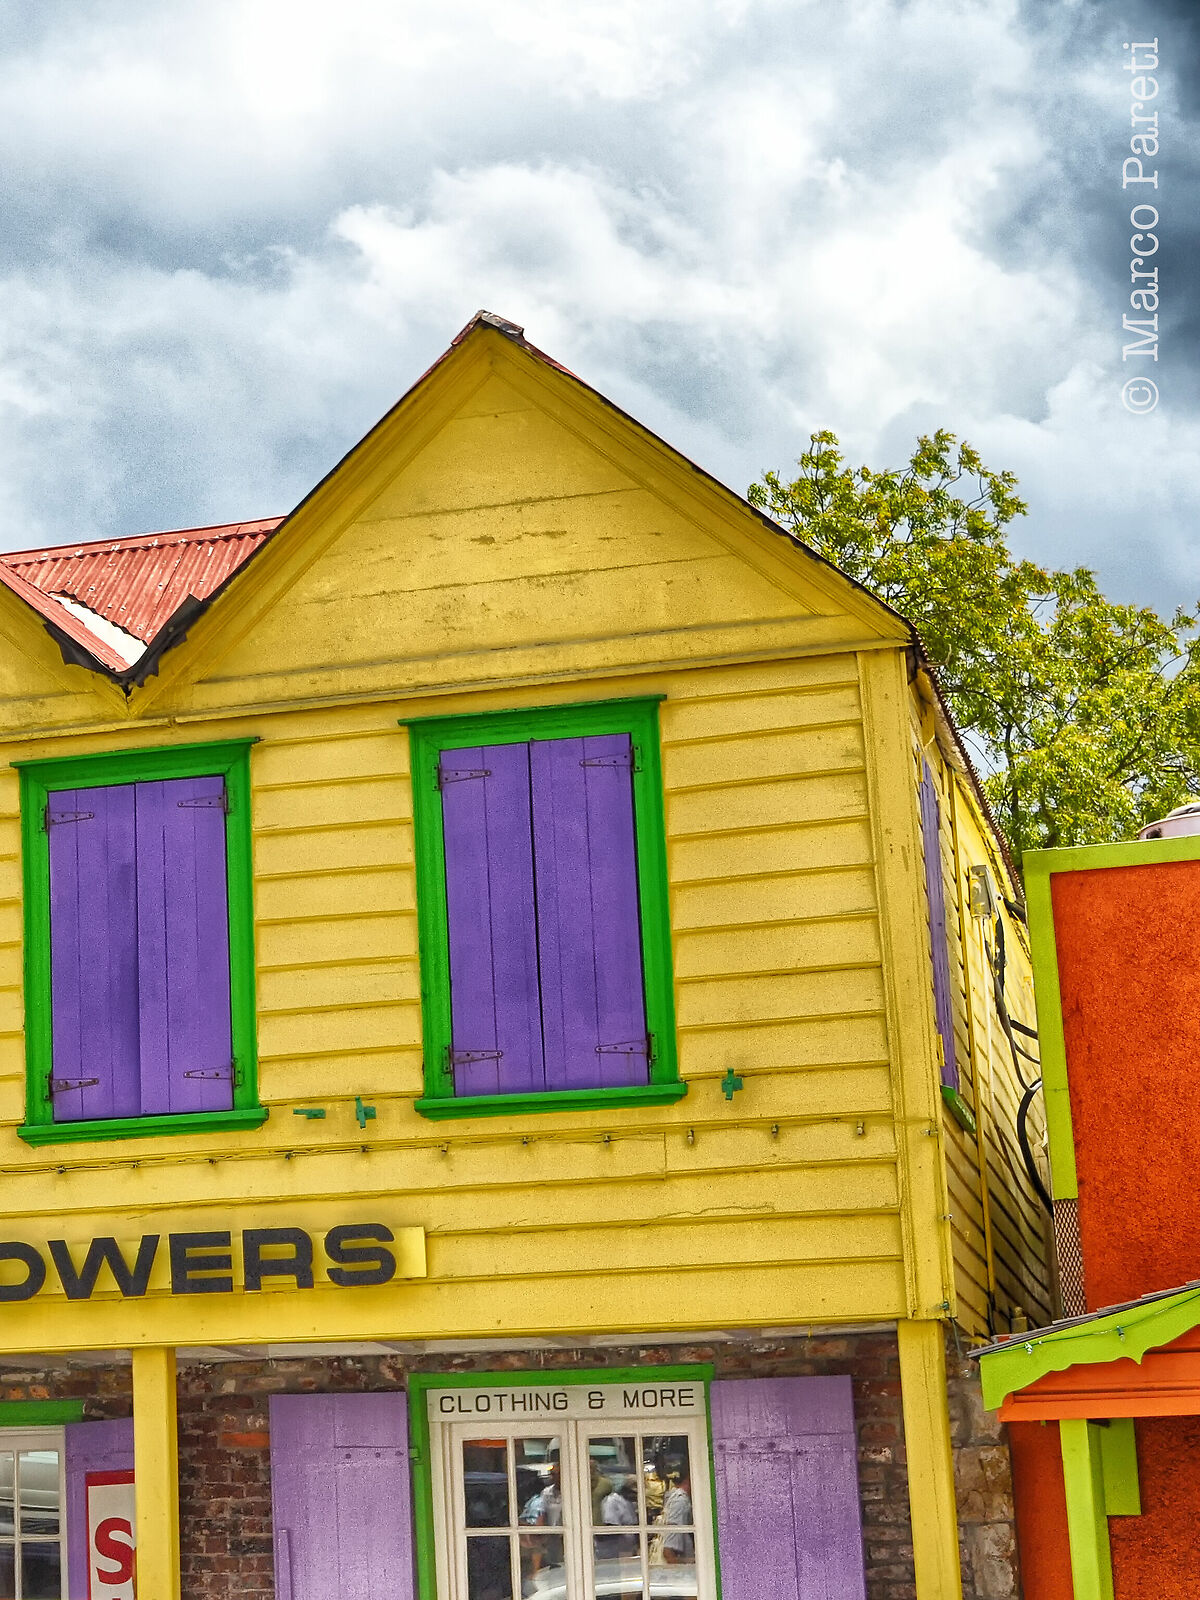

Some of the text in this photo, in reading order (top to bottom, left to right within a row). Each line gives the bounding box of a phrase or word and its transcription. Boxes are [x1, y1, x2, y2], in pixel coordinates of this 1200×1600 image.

[440, 1388, 695, 1414] CLOTHING & MORE
